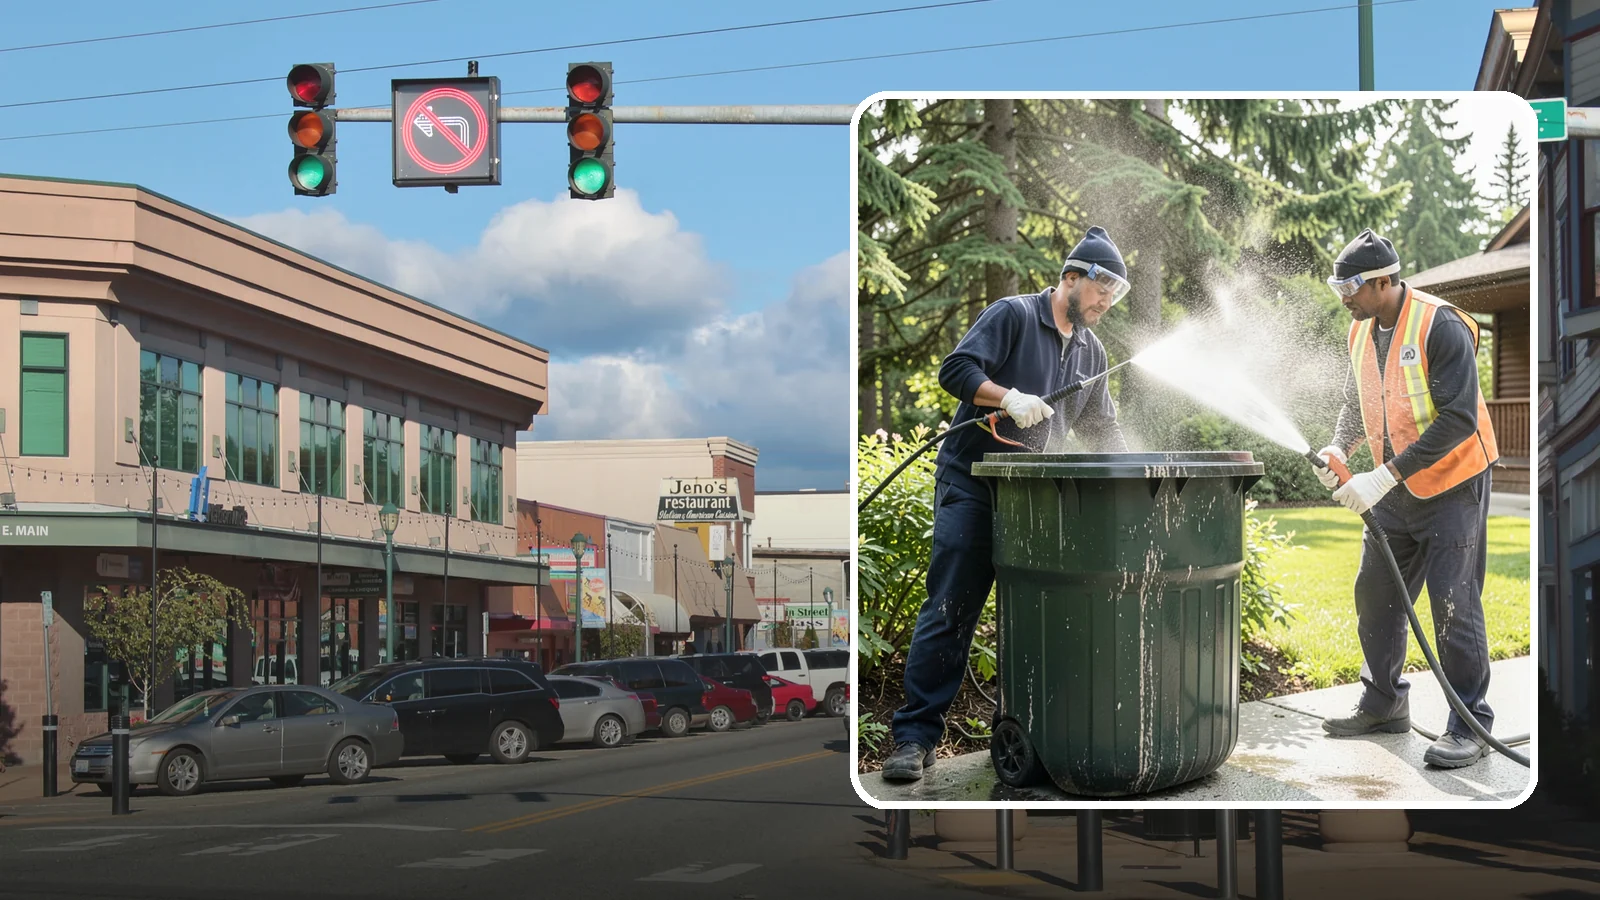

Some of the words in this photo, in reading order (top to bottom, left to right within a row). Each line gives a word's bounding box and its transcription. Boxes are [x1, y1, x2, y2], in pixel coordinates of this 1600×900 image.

[670, 480, 727, 494] Jeno's
[665, 496, 731, 508] restaurant
[659, 510, 681, 519] Italian
[686, 509, 714, 519] American
[715, 509, 738, 519] Cuisine
[2, 525, 13, 536] E.
[15, 525, 49, 536] MAIN
[786, 607, 795, 616] in
[797, 607, 828, 616] Street
